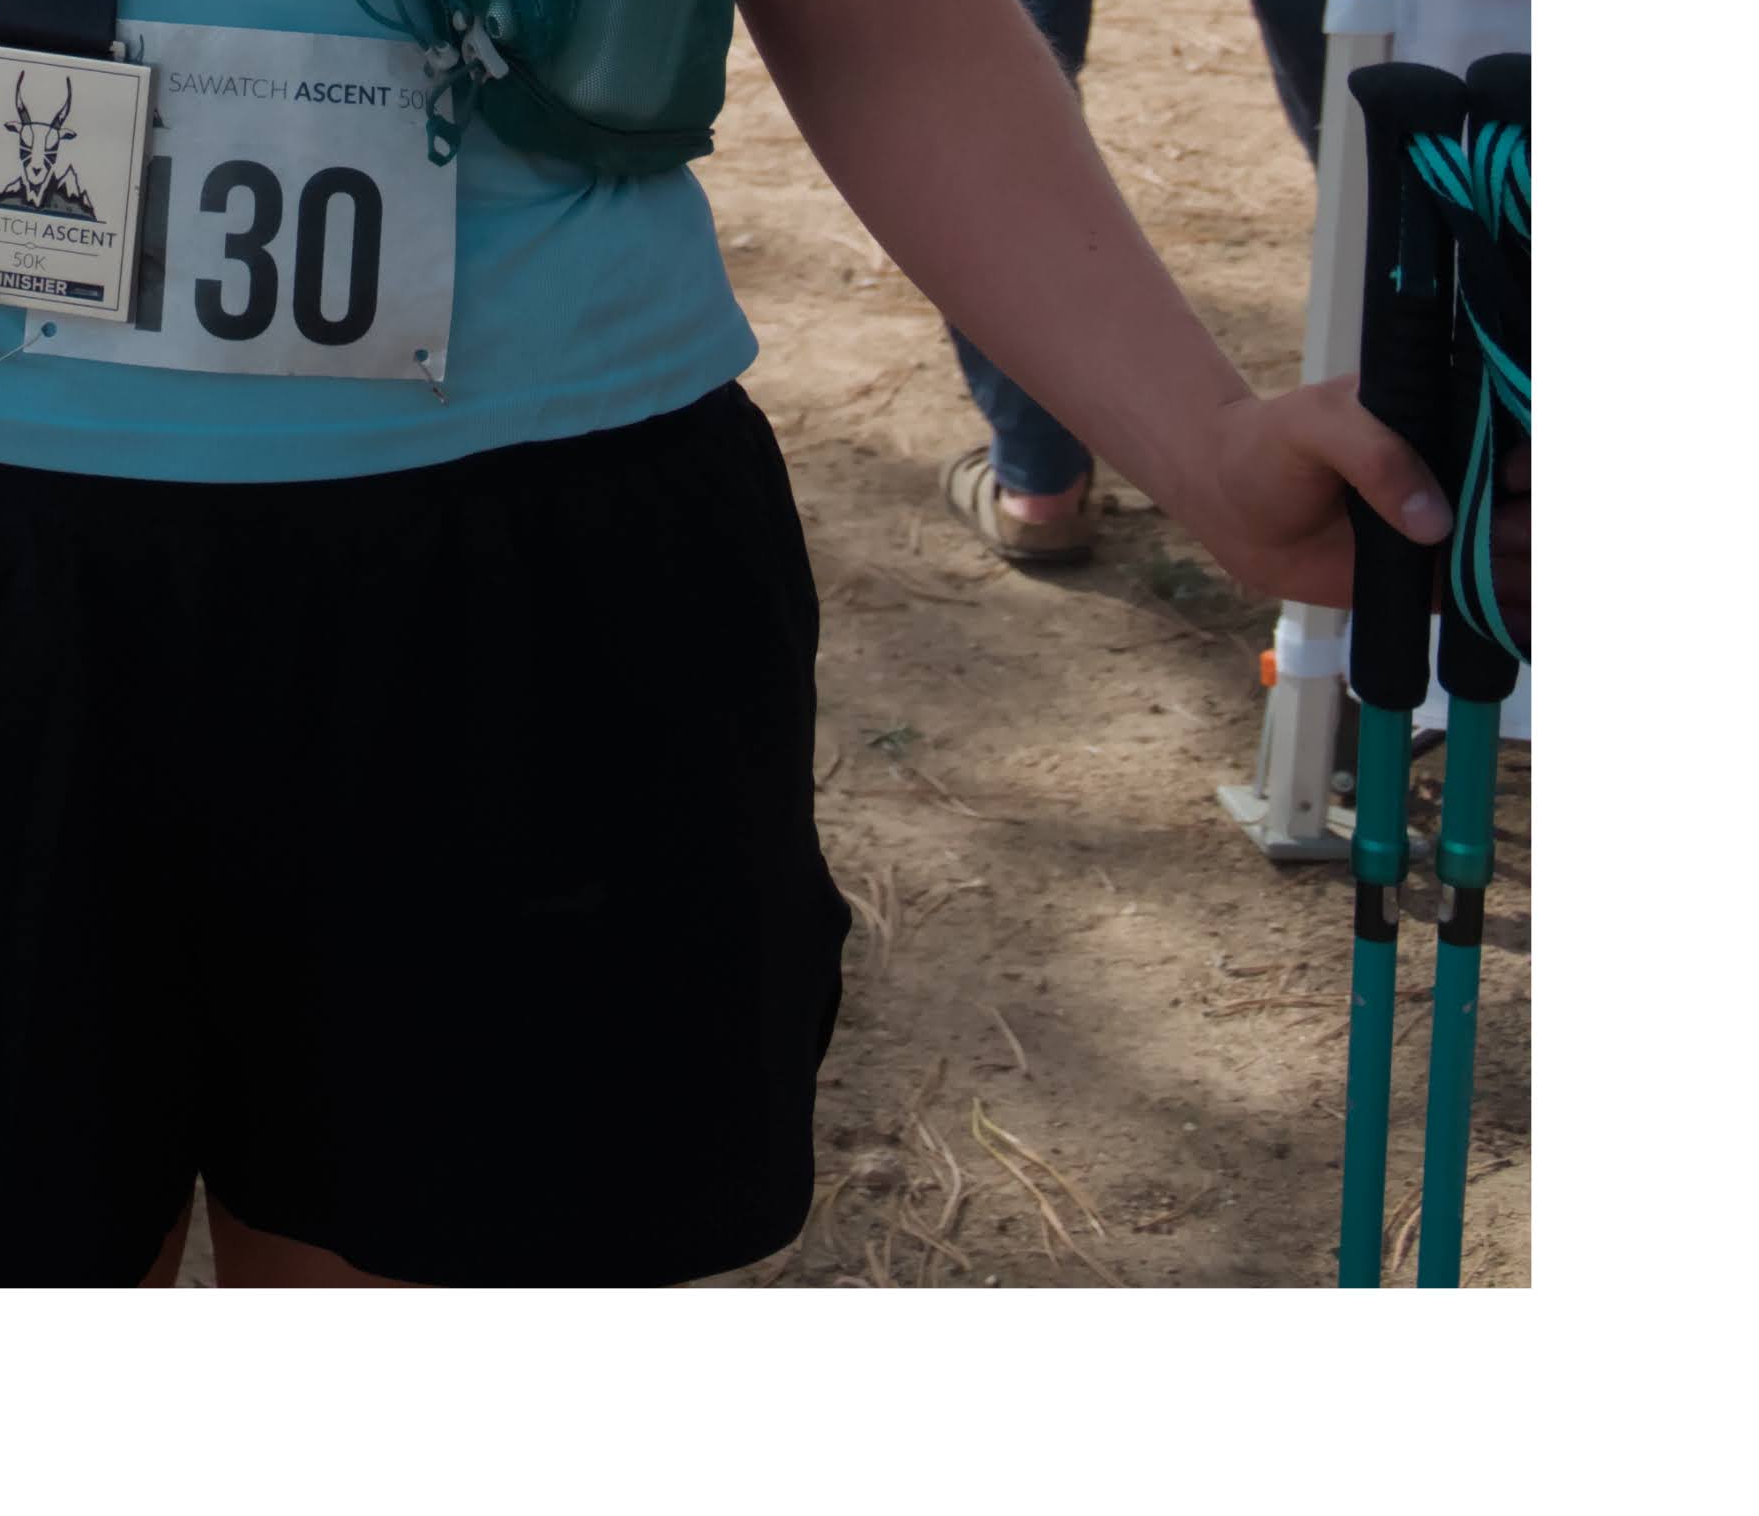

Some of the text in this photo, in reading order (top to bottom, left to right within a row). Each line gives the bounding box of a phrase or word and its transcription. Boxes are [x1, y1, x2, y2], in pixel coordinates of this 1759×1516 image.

[168, 71, 288, 101] SAWATCH
[294, 81, 391, 107] ASCENT
[42, 224, 118, 248] ASCENT
[13, 251, 48, 270] 50K
